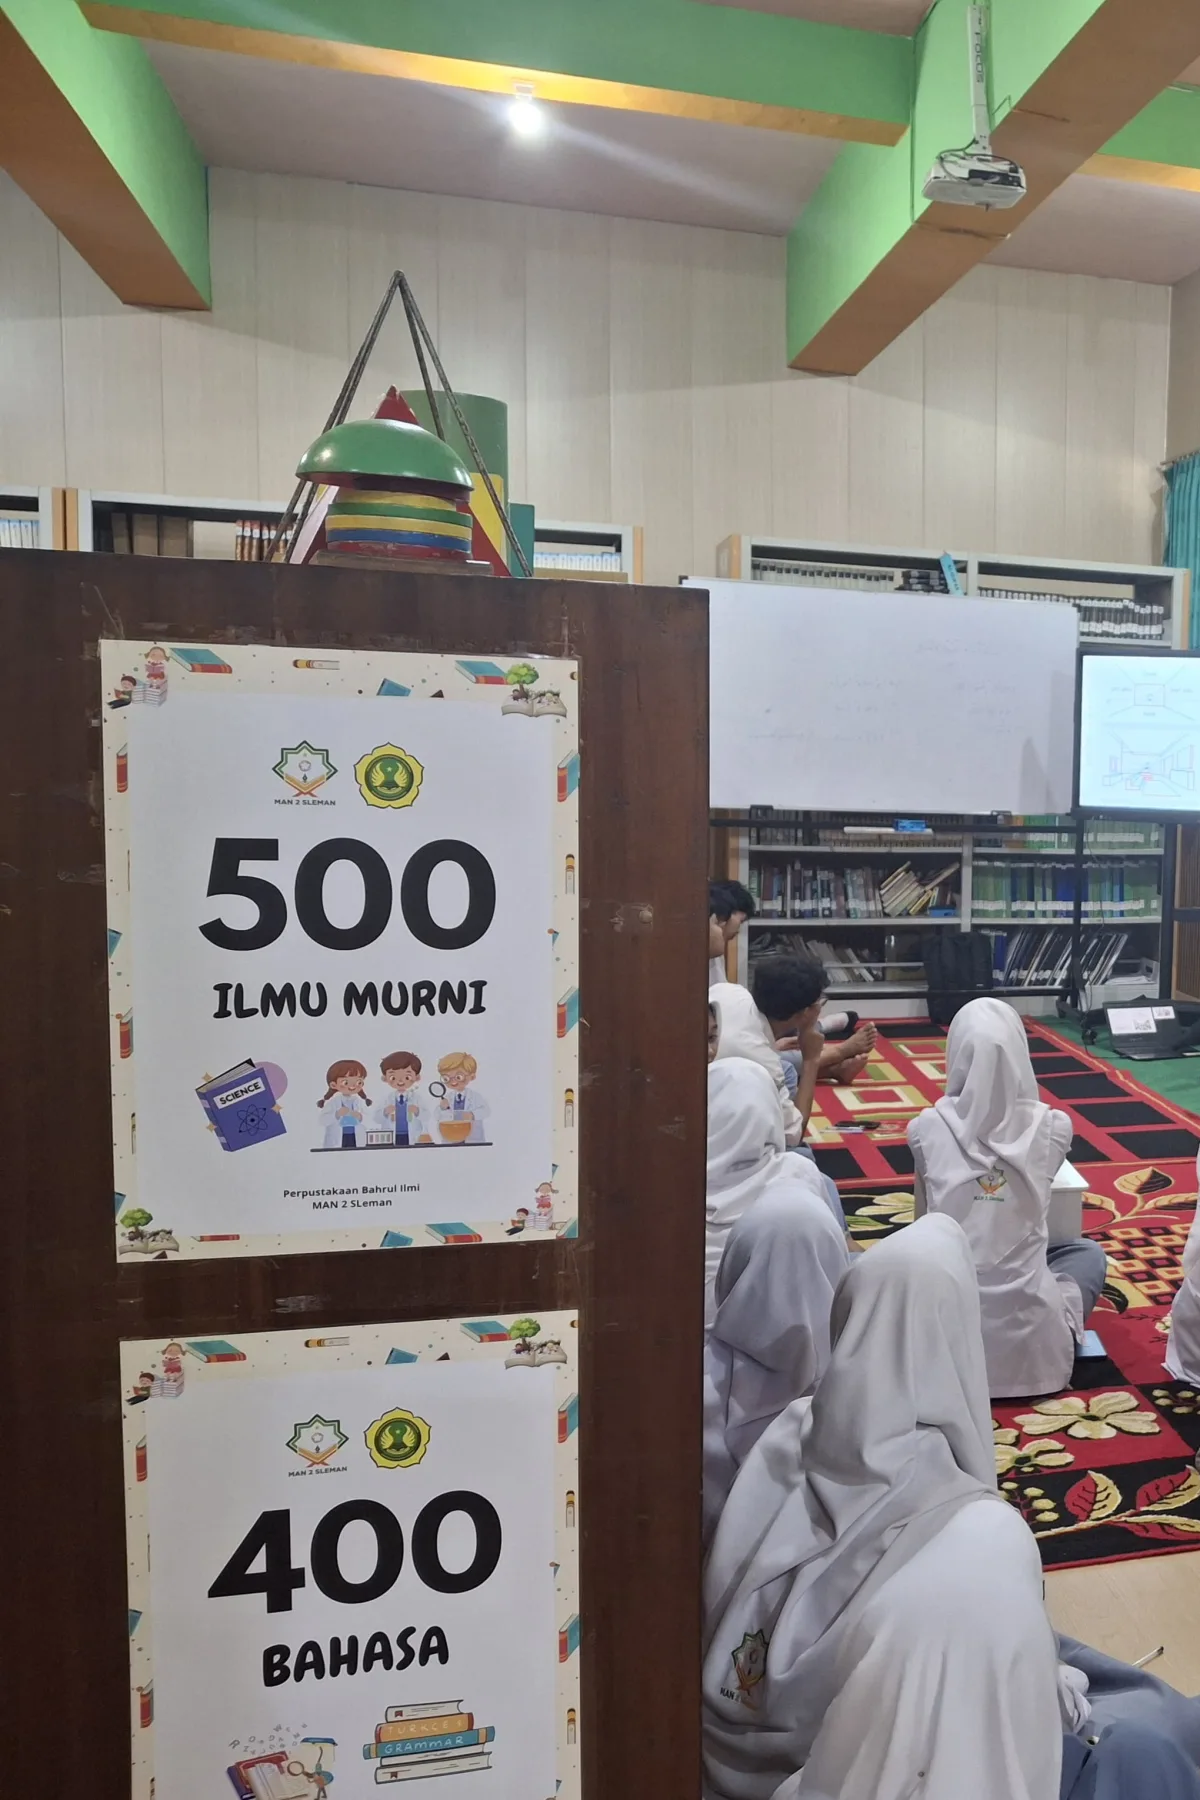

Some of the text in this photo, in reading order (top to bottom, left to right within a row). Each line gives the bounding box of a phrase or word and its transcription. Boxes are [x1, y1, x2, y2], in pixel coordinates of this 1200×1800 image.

[198, 837, 496, 951] 500
[213, 980, 488, 1019] ILMU MURNI
[219, 1082, 261, 1105] SCIENCE
[283, 1183, 420, 1199] Perpustakaan Bahrul Ilmi
[312, 1199, 392, 1210] MAN 2 SLeman
[315, 1466, 347, 1475] SLEMAN
[207, 1490, 502, 1614] 400
[263, 1626, 449, 1687] BAHASA
